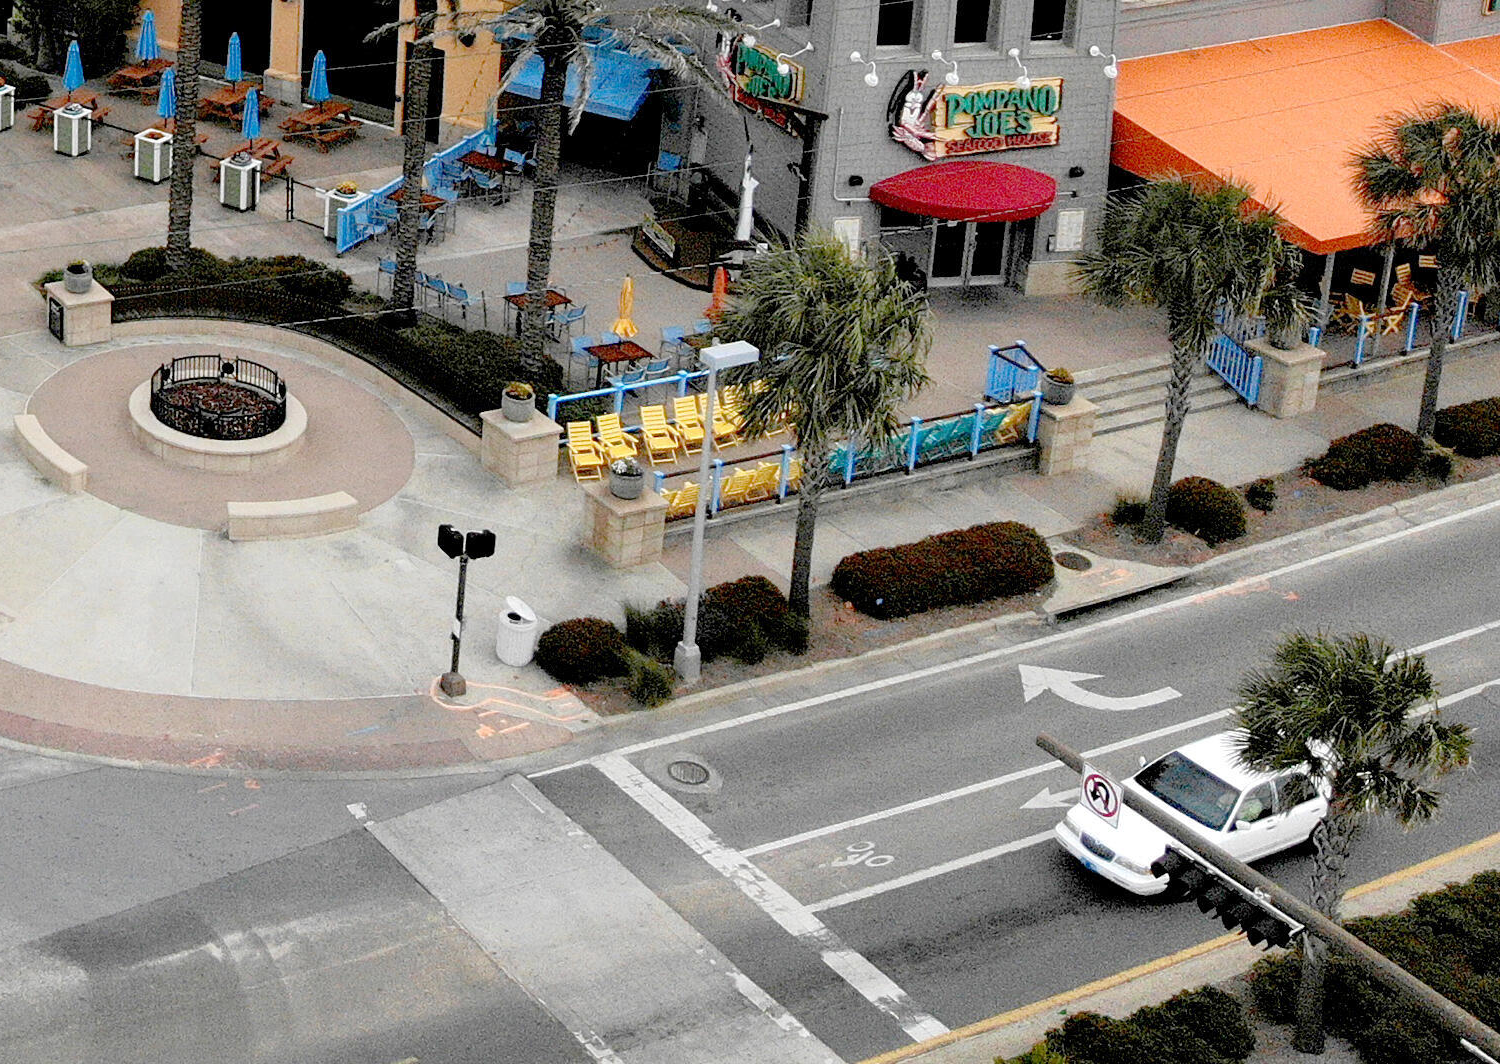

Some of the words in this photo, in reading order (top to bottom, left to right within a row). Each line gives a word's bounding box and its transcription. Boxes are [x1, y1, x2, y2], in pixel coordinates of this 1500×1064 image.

[944, 84, 1057, 128] POMPANO
[945, 136, 1004, 154] SEAFOOD
[1006, 131, 1054, 147] HOUSE
